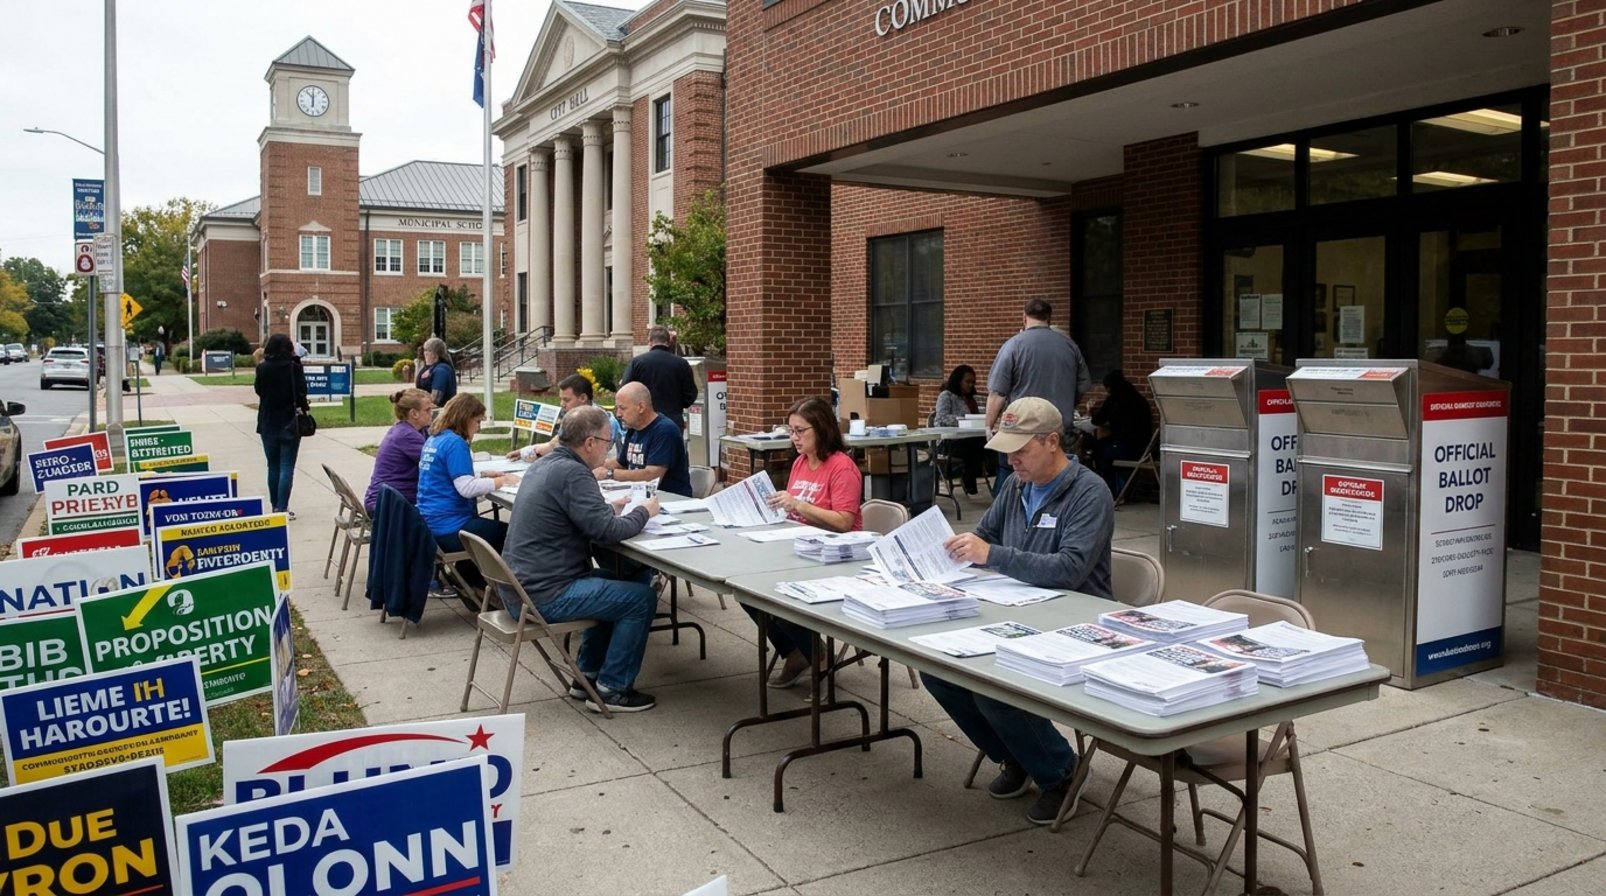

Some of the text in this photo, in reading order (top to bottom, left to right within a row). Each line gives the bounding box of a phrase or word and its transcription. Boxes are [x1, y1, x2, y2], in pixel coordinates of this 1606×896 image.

[875, 0, 969, 36] COM
[398, 218, 452, 228] MUNICIPAL
[1434, 442, 1496, 463] OFFICIAL
[67, 481, 119, 497] PARD
[1439, 467, 1492, 488] BALLOT
[1445, 493, 1484, 513] DROP
[0, 572, 145, 614] NATIN
[95, 605, 272, 663] PROPOSITION
[36, 685, 126, 721] LIEME
[19, 697, 192, 750] HAROURTE!
[5, 808, 117, 861] DUE
[200, 808, 350, 872] KEDA
